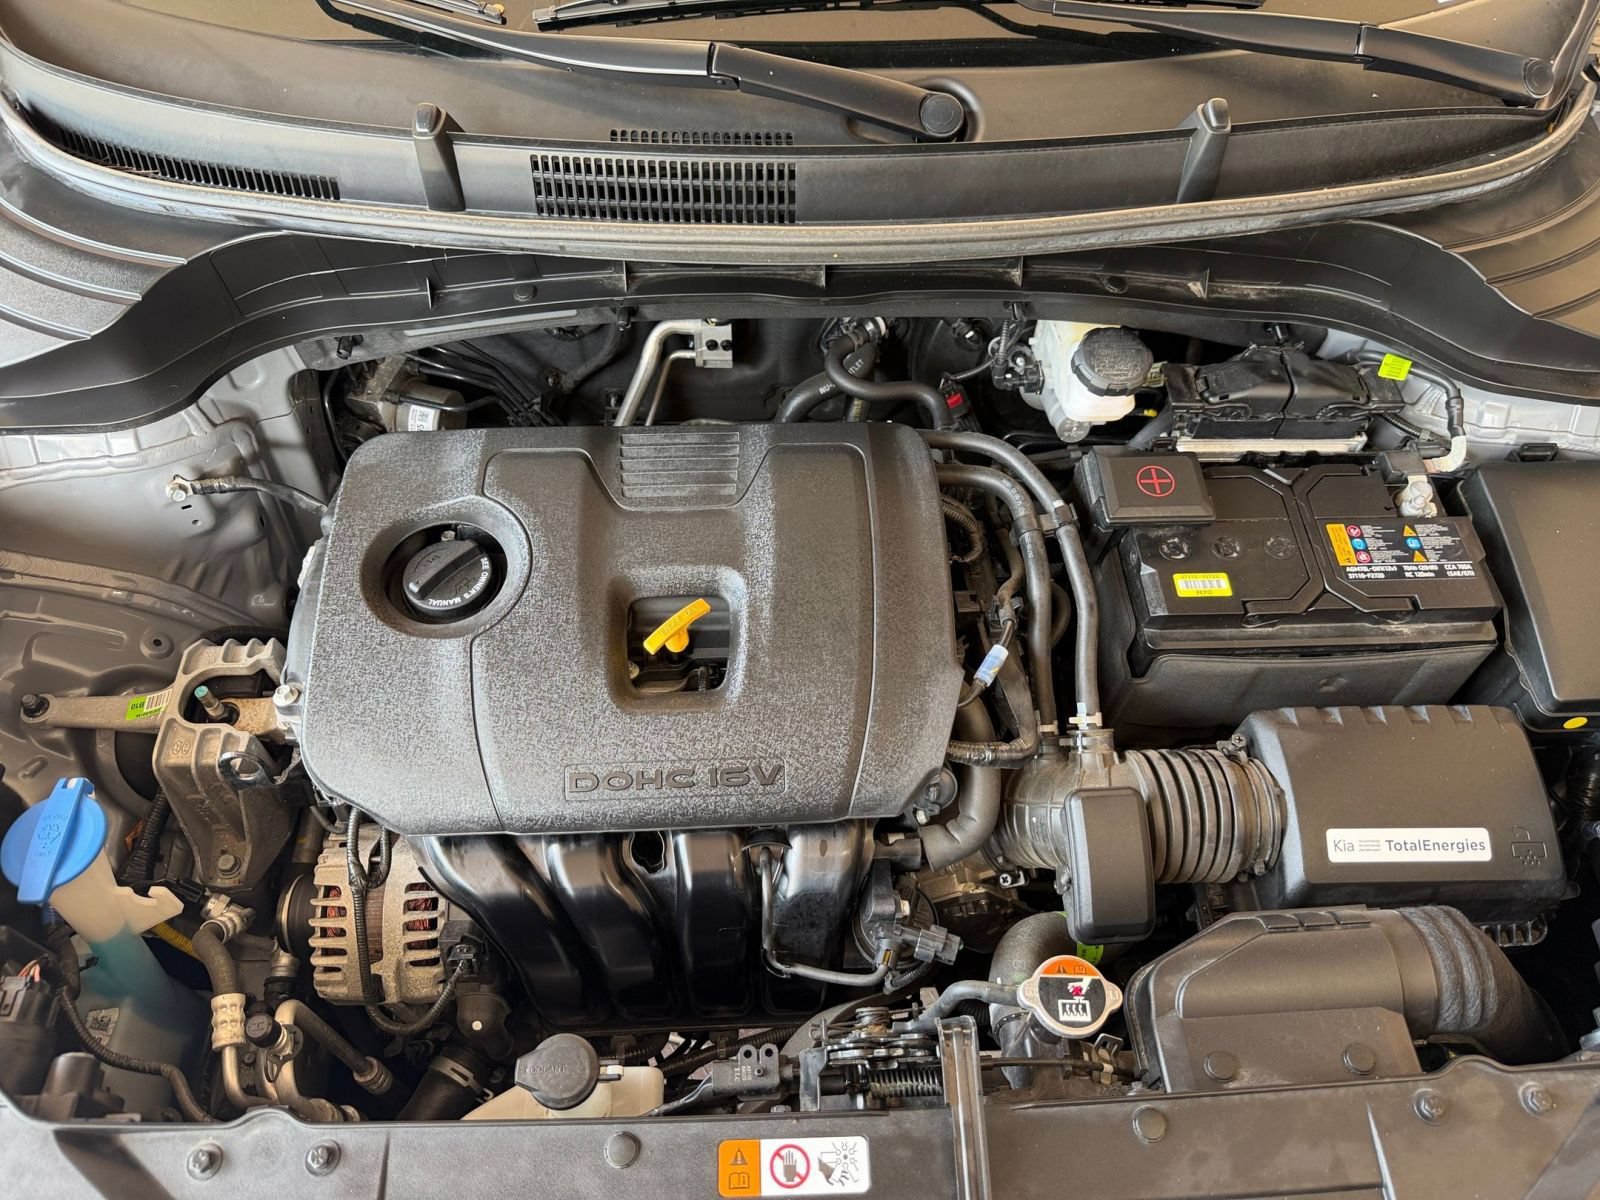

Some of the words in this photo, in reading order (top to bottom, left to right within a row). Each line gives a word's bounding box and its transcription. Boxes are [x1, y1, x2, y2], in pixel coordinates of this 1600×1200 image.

[480, 557, 490, 570] SEE
[463, 571, 489, 599] OWNER'S
[427, 596, 462, 606] MANUAL
[568, 768, 695, 793] DOHC
[708, 763, 784, 787] 16V
[1333, 839, 1355, 852] Kia
[1385, 838, 1486, 853] TotalEnergies
